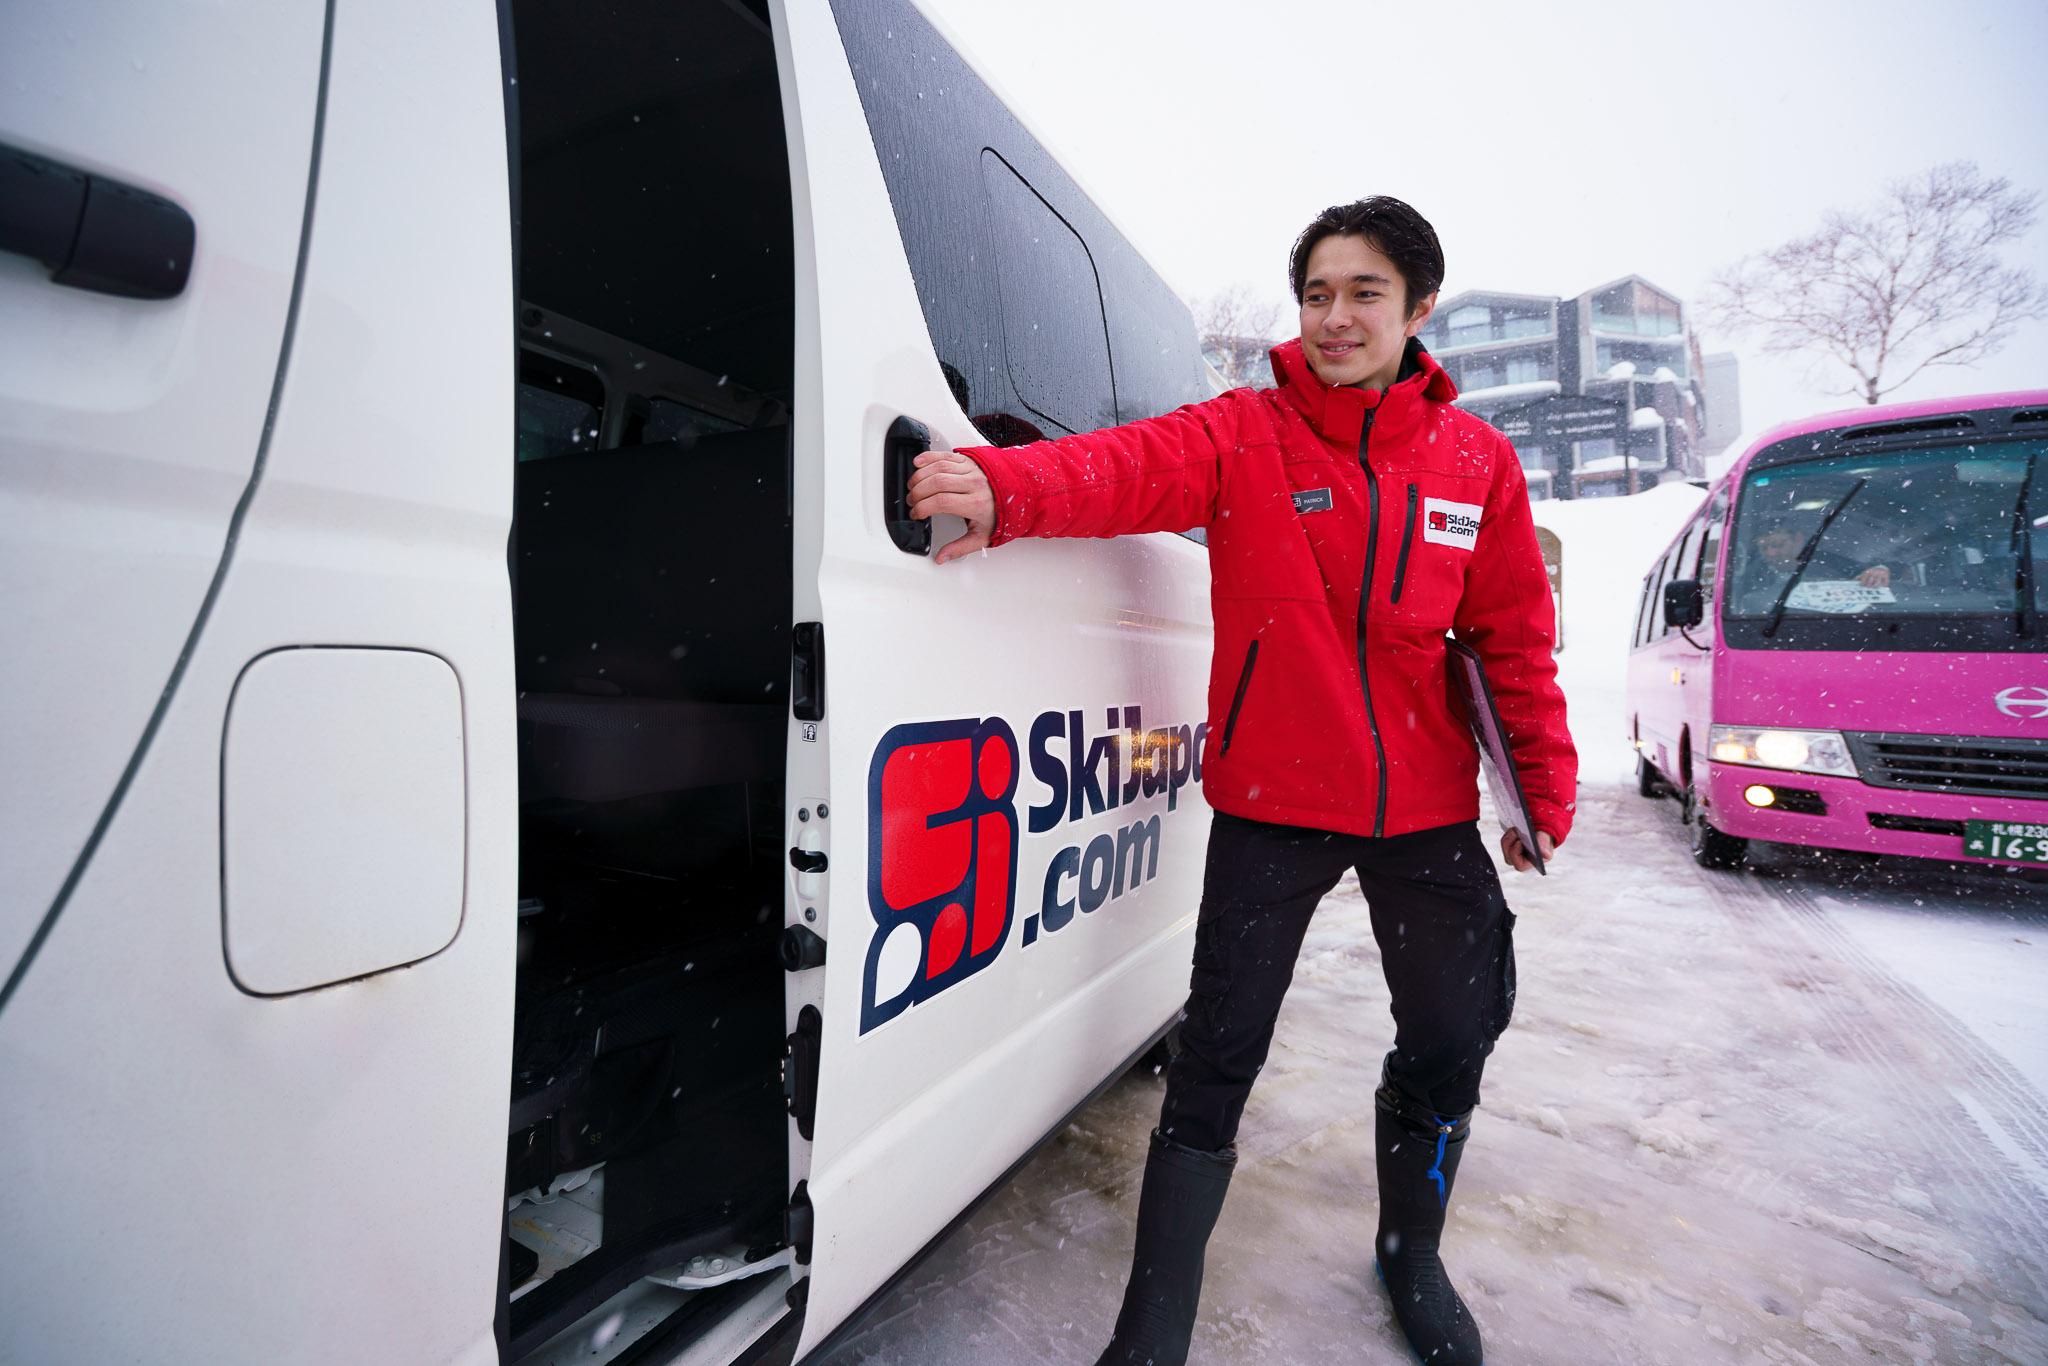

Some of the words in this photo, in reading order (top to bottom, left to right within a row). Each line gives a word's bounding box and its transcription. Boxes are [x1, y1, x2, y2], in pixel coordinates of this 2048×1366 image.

[1303, 497, 1324, 505] PATRICK
[1447, 526, 1474, 537] .com
[1021, 814, 1161, 948] .com
